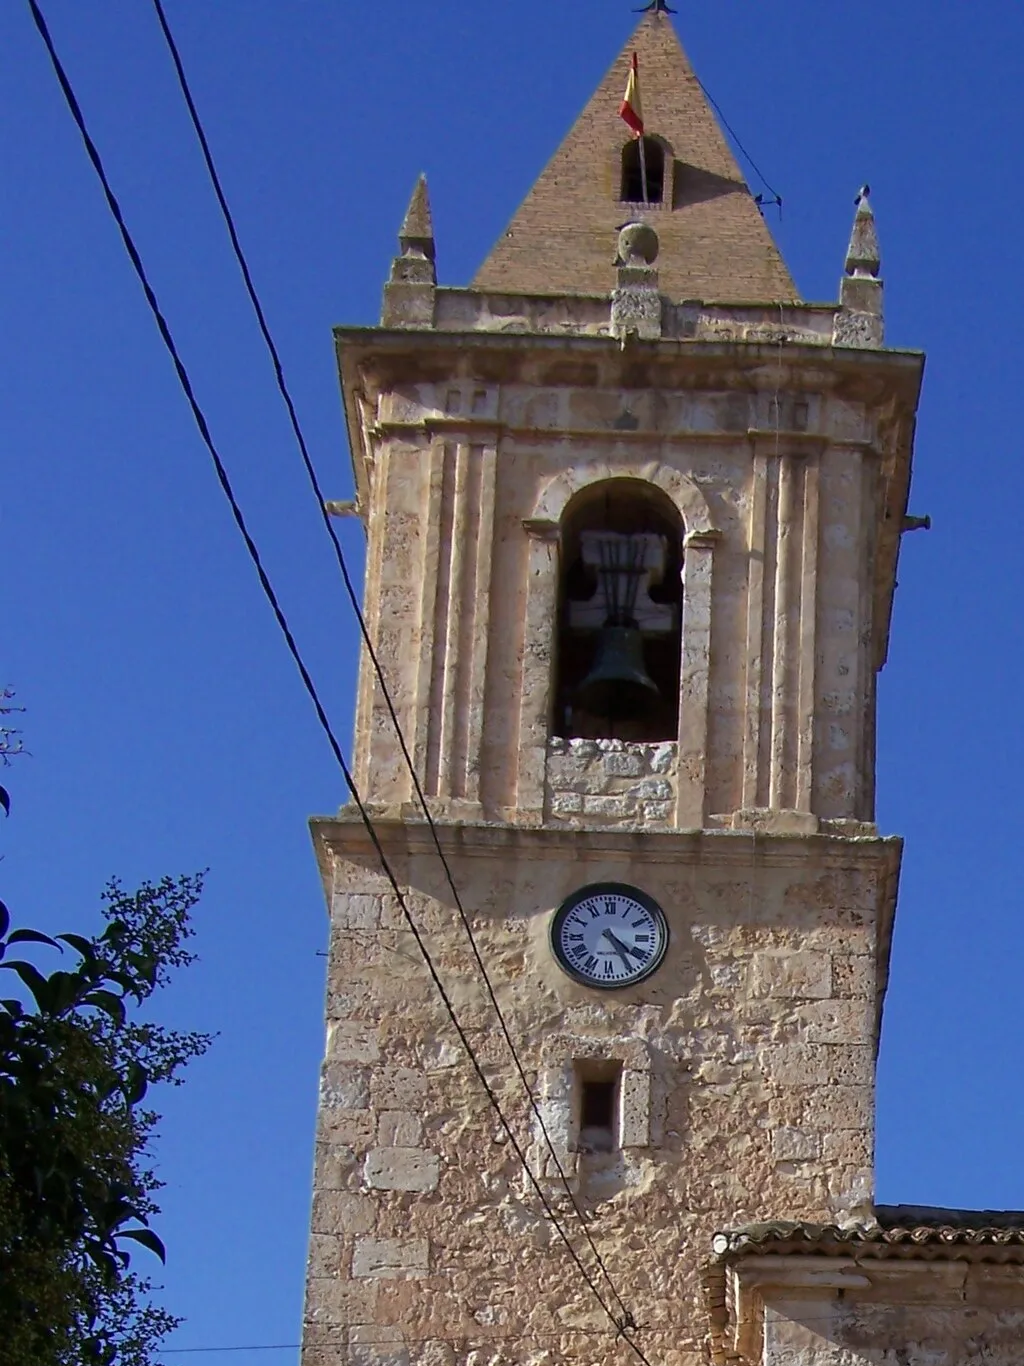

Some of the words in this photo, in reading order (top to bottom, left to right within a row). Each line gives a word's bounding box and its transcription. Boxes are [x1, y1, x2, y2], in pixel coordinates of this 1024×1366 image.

[587, 905, 600, 918] XI
[605, 902, 616, 914] XII
[622, 907, 630, 918] I
[605, 961, 613, 973] VI
